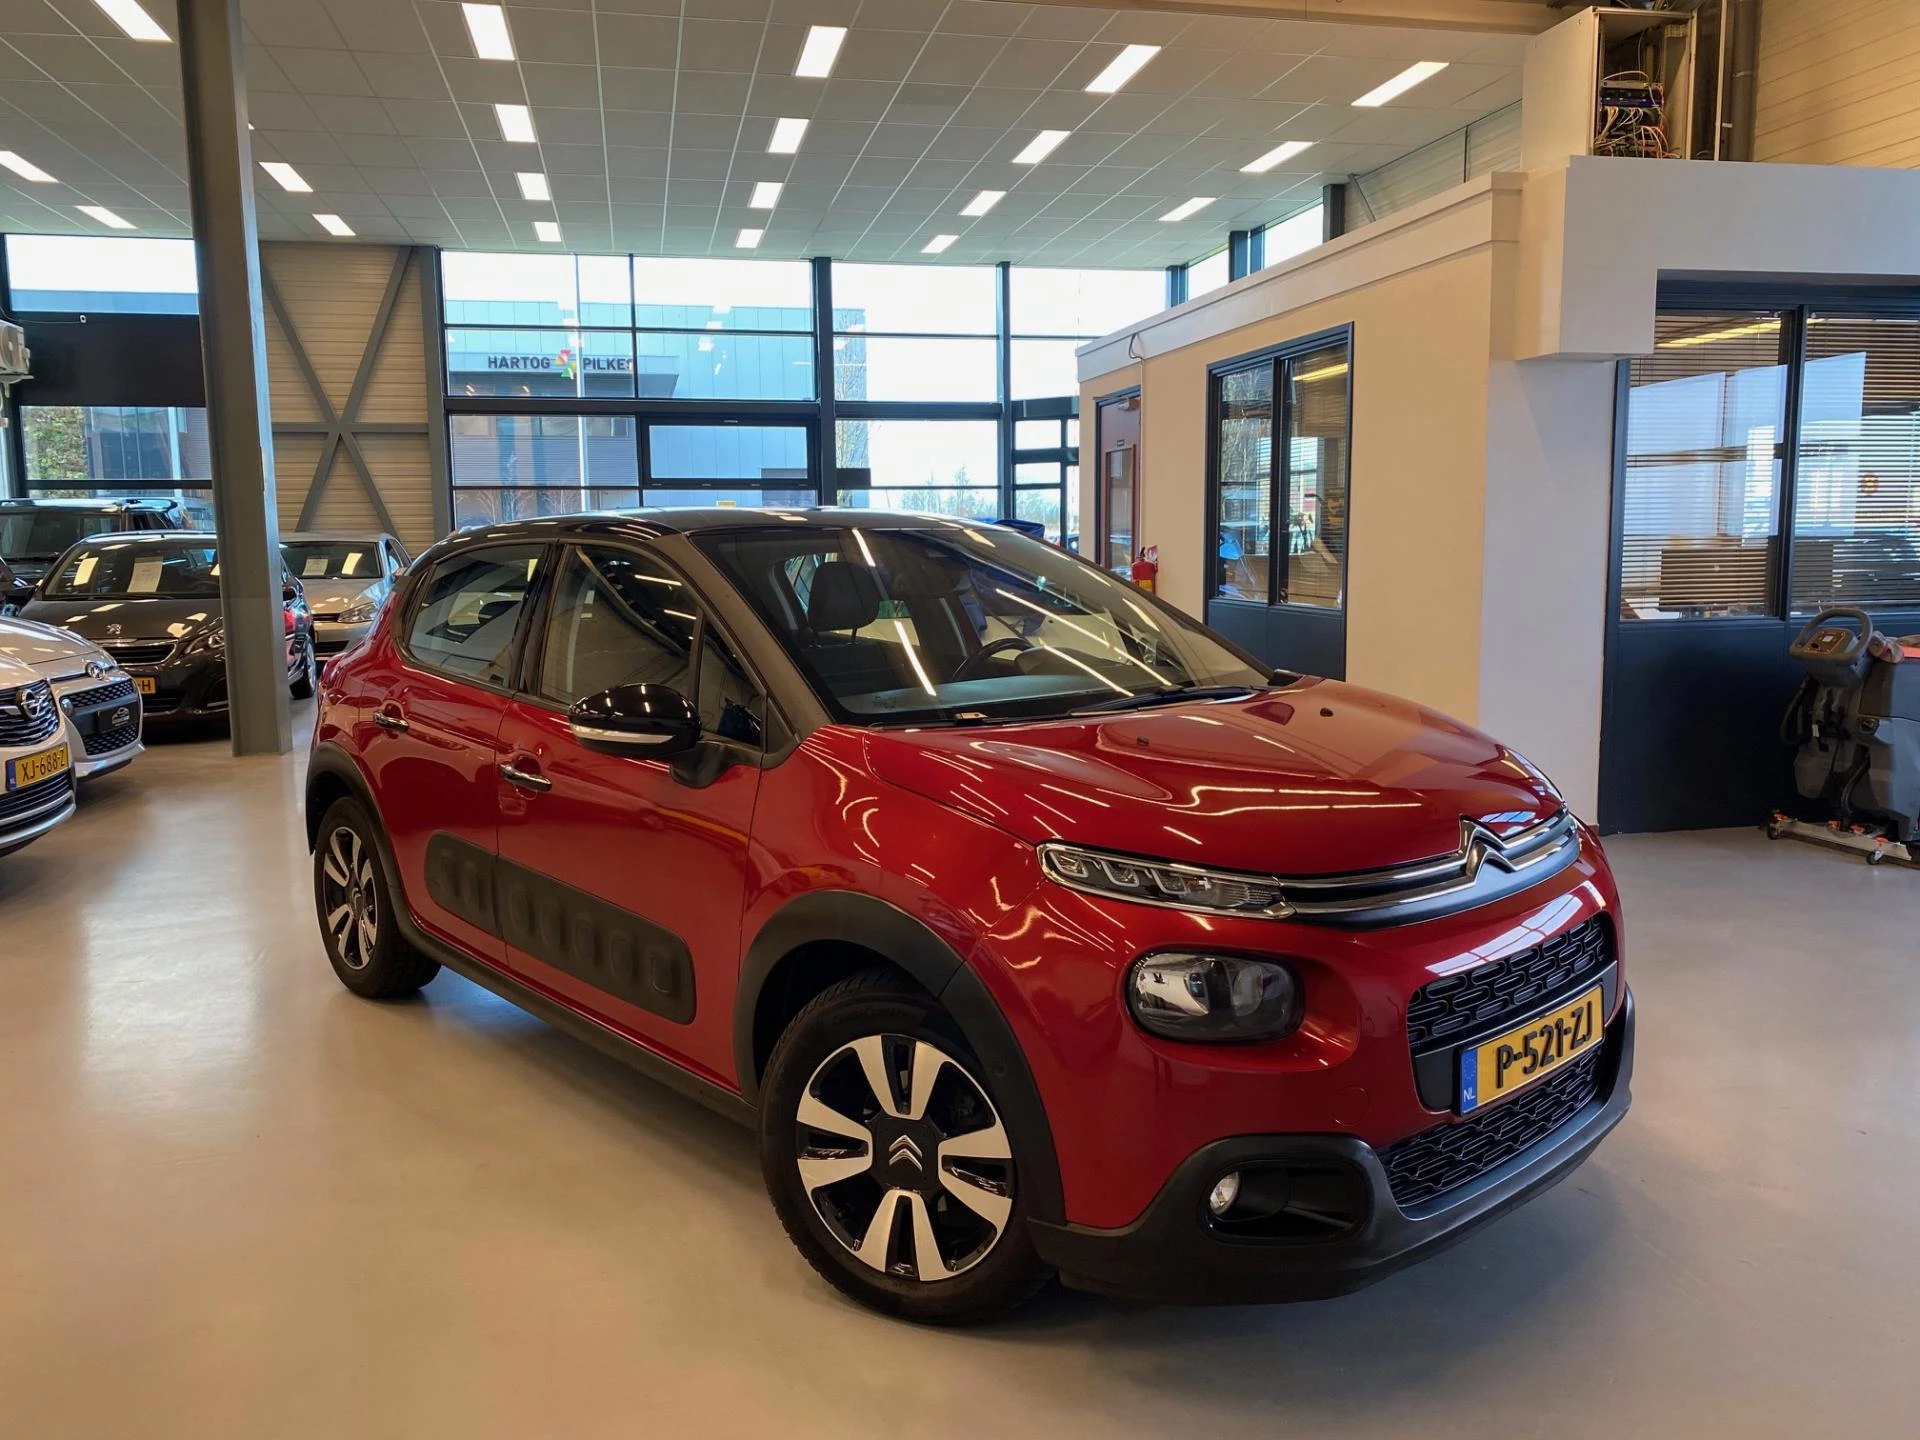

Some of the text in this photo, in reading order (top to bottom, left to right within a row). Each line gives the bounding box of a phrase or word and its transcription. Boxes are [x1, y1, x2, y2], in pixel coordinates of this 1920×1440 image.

[488, 356, 550, 369] HARTOG
[22, 749, 65, 782] XJ-688-Z
[1496, 1000, 1593, 1089] P-521-ZJ
[1463, 1086, 1476, 1102] NL
